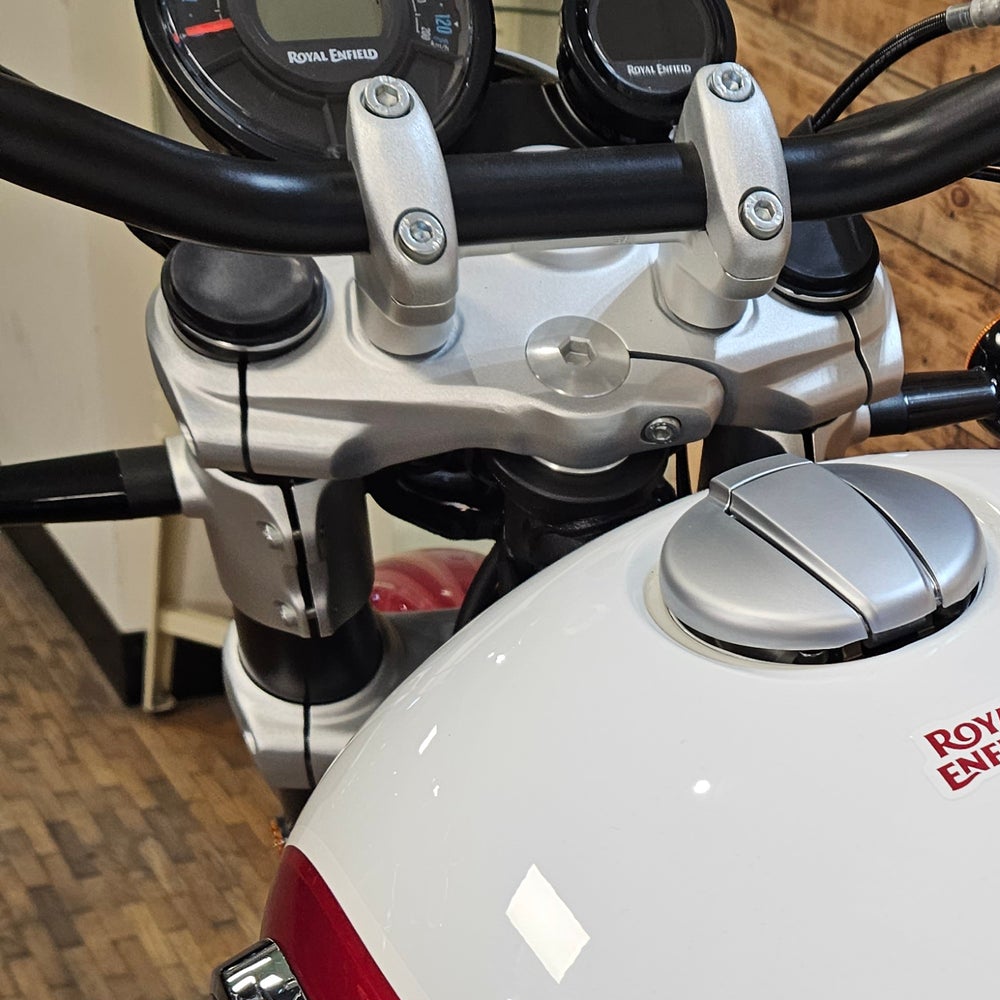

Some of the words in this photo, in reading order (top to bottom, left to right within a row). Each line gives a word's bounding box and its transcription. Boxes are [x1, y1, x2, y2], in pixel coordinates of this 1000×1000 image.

[434, 14, 452, 35] 120
[287, 51, 328, 64] ROYAL
[328, 48, 379, 63] ENFIELD
[627, 64, 655, 76] ROYAL
[657, 63, 692, 76] ENFIELD
